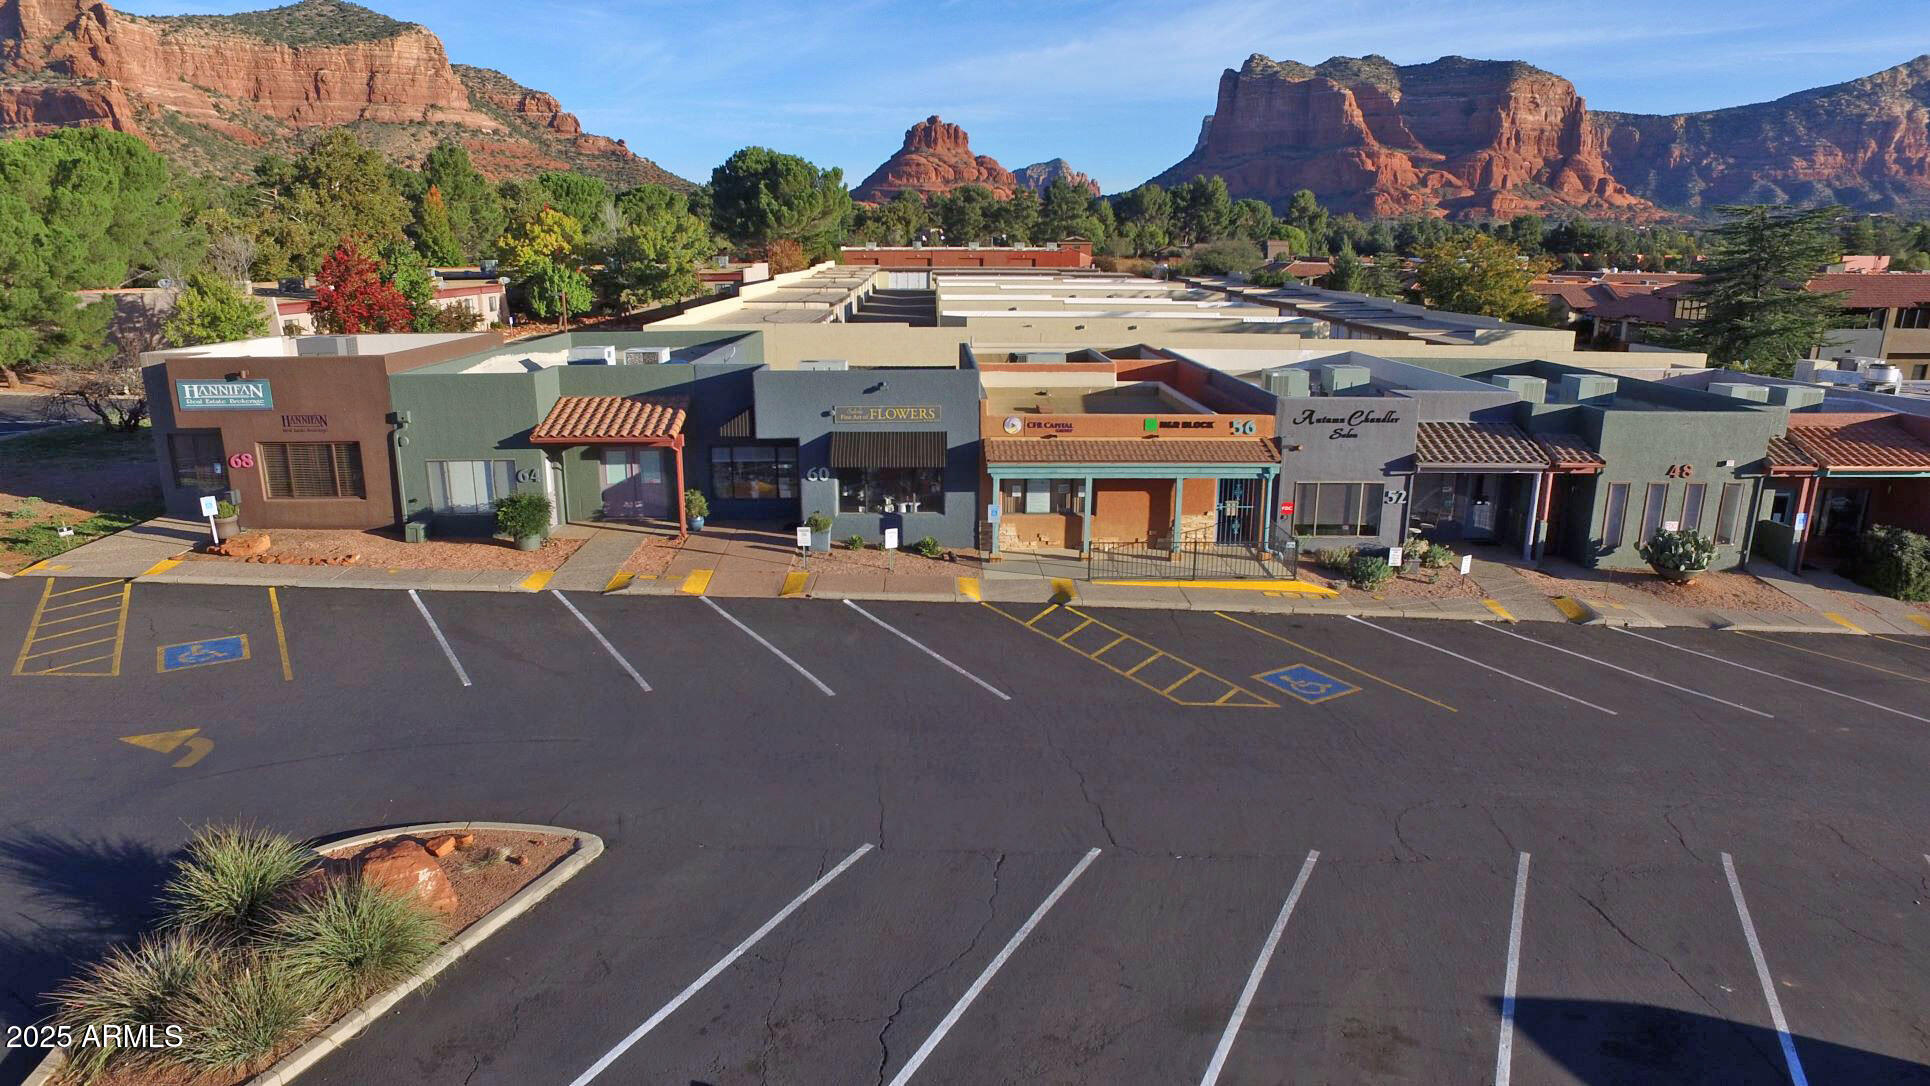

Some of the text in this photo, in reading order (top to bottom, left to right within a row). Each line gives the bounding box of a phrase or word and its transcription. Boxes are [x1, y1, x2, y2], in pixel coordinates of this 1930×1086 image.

[182, 383, 264, 398] HANNIFAN
[281, 414, 328, 427] HANNIFAN
[869, 408, 936, 420] FLOWERS
[1347, 410, 1400, 427] Chandler
[1181, 421, 1216, 429] BLOCK
[1230, 417, 1257, 435] 56
[229, 452, 254, 468] 68
[517, 468, 541, 483] 64
[806, 466, 830, 482] 60
[1667, 464, 1694, 478] 48
[1386, 490, 1407, 504] 52
